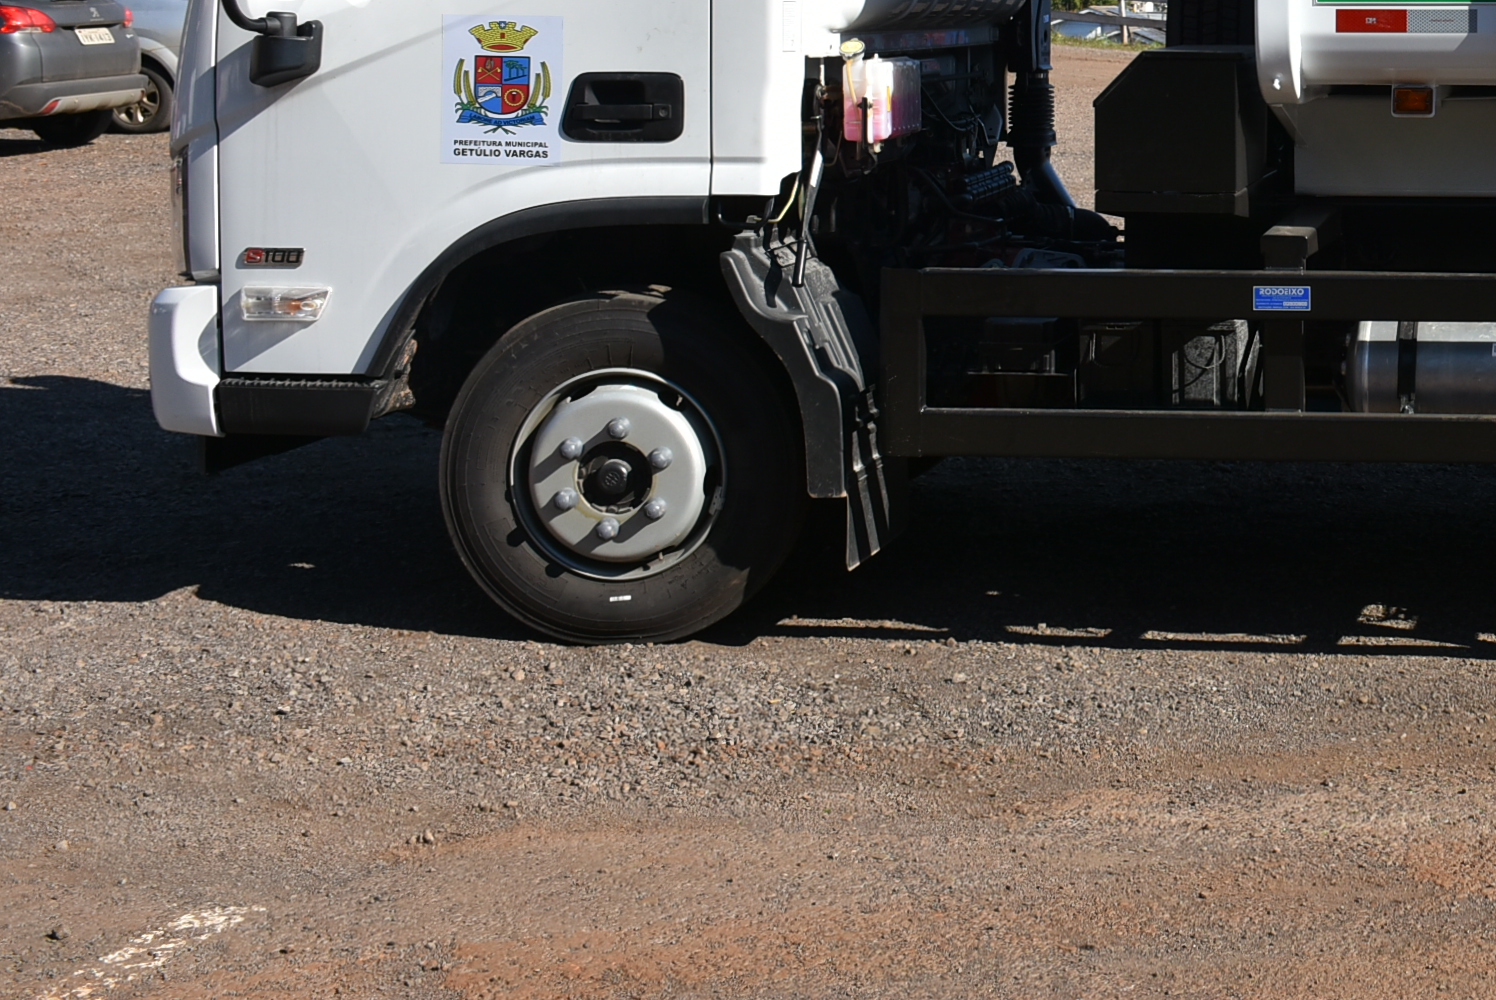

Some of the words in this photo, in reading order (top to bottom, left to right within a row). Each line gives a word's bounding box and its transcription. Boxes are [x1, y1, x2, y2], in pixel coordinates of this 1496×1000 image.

[453, 139, 503, 147] PREFEITURA
[453, 147, 501, 157] GETÚLIO
[504, 149, 549, 158] VARGAS
